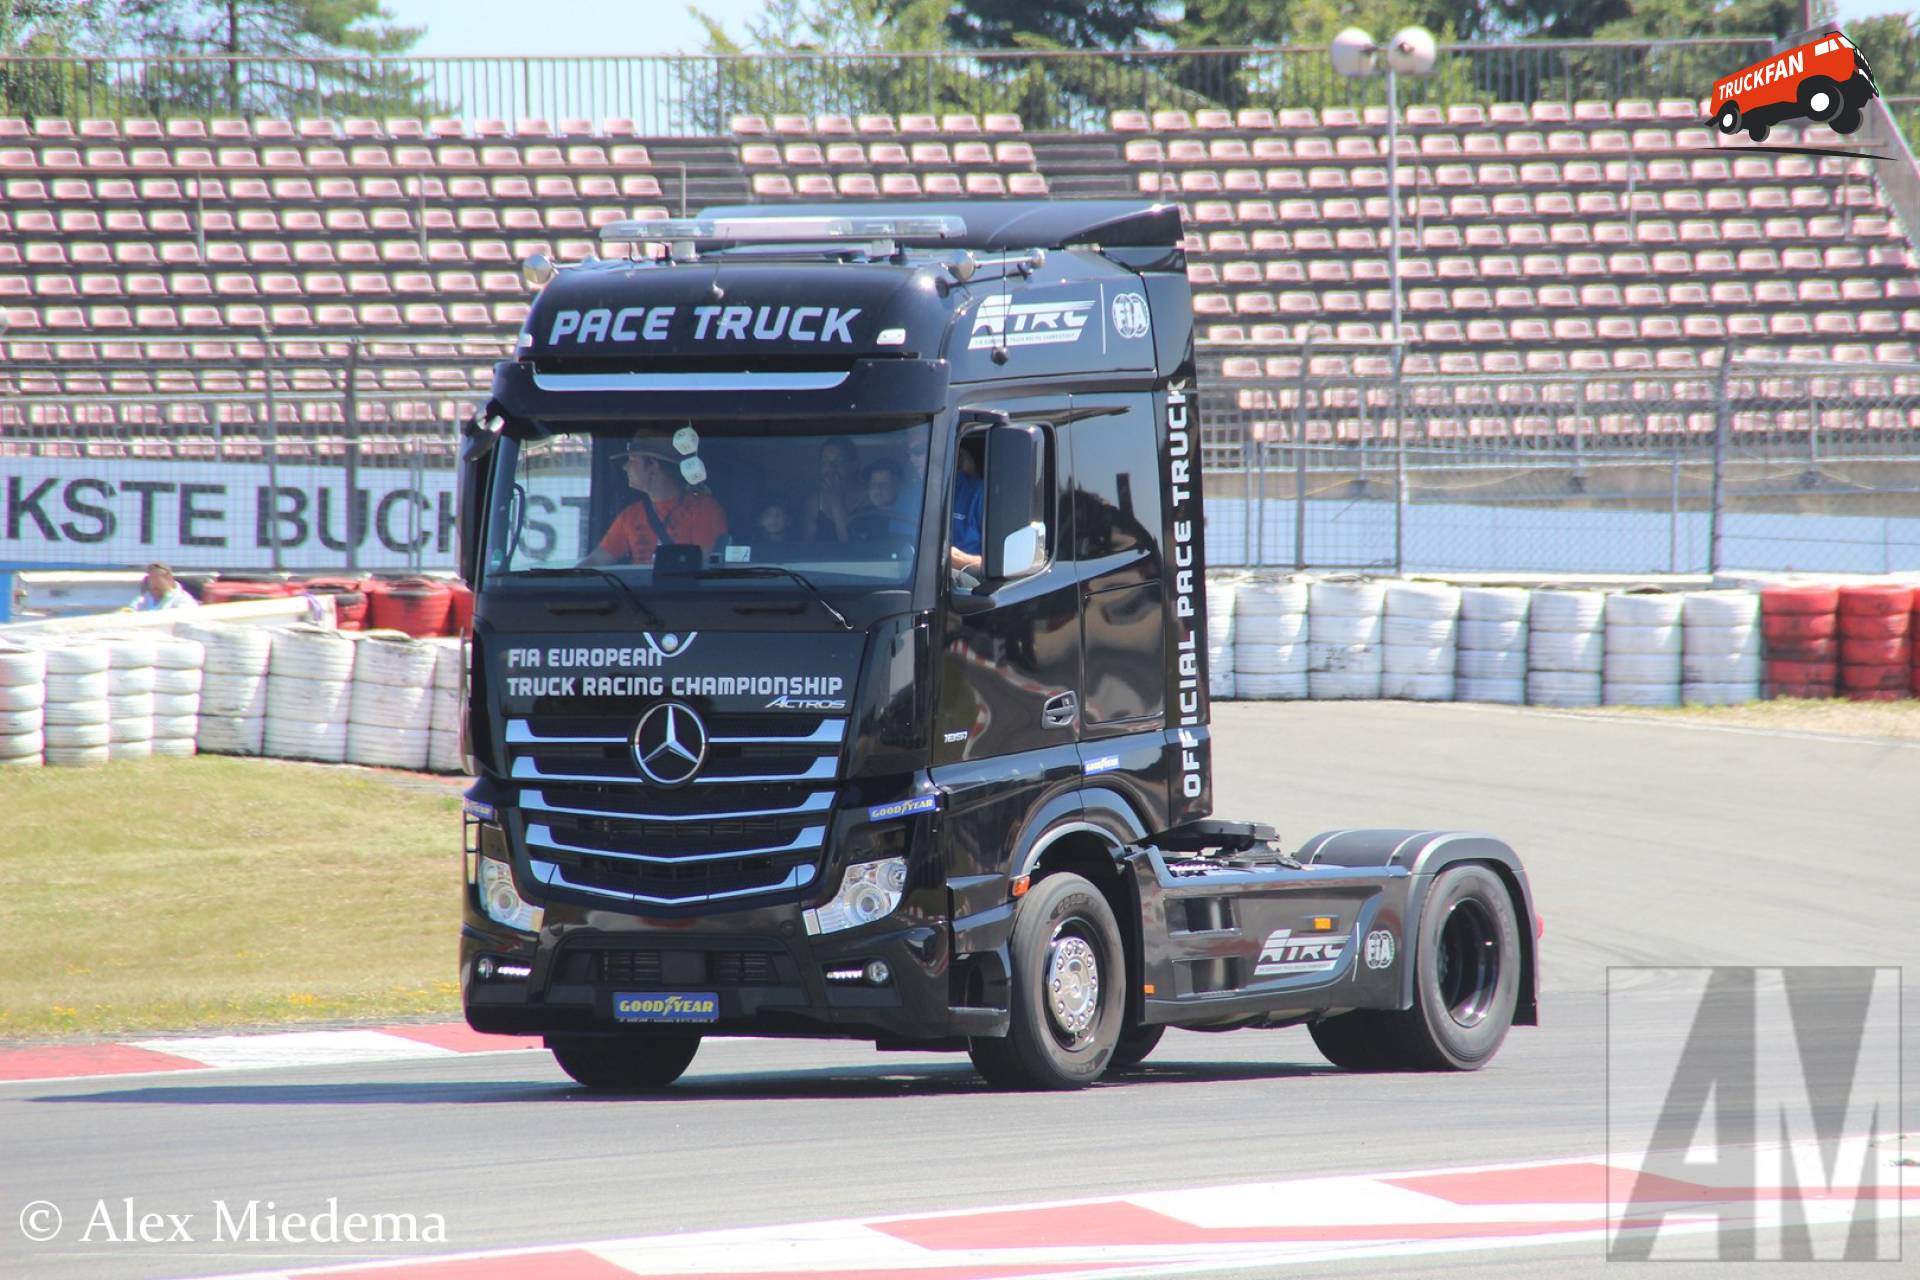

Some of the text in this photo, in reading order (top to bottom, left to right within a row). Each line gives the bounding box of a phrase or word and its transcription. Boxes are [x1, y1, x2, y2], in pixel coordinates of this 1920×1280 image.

[548, 306, 862, 346] PACE TRUCK
[6, 475, 229, 549] KSTE
[1167, 379, 1201, 798] OFFICIAL PACE TRUCK
[507, 647, 663, 668] FIA EUROPEAN
[507, 676, 844, 697] TRUCK RACING CHAMPIONSHIP
[870, 798, 934, 818] GOODYEAR
[619, 995, 715, 1016] GOODYEAR
